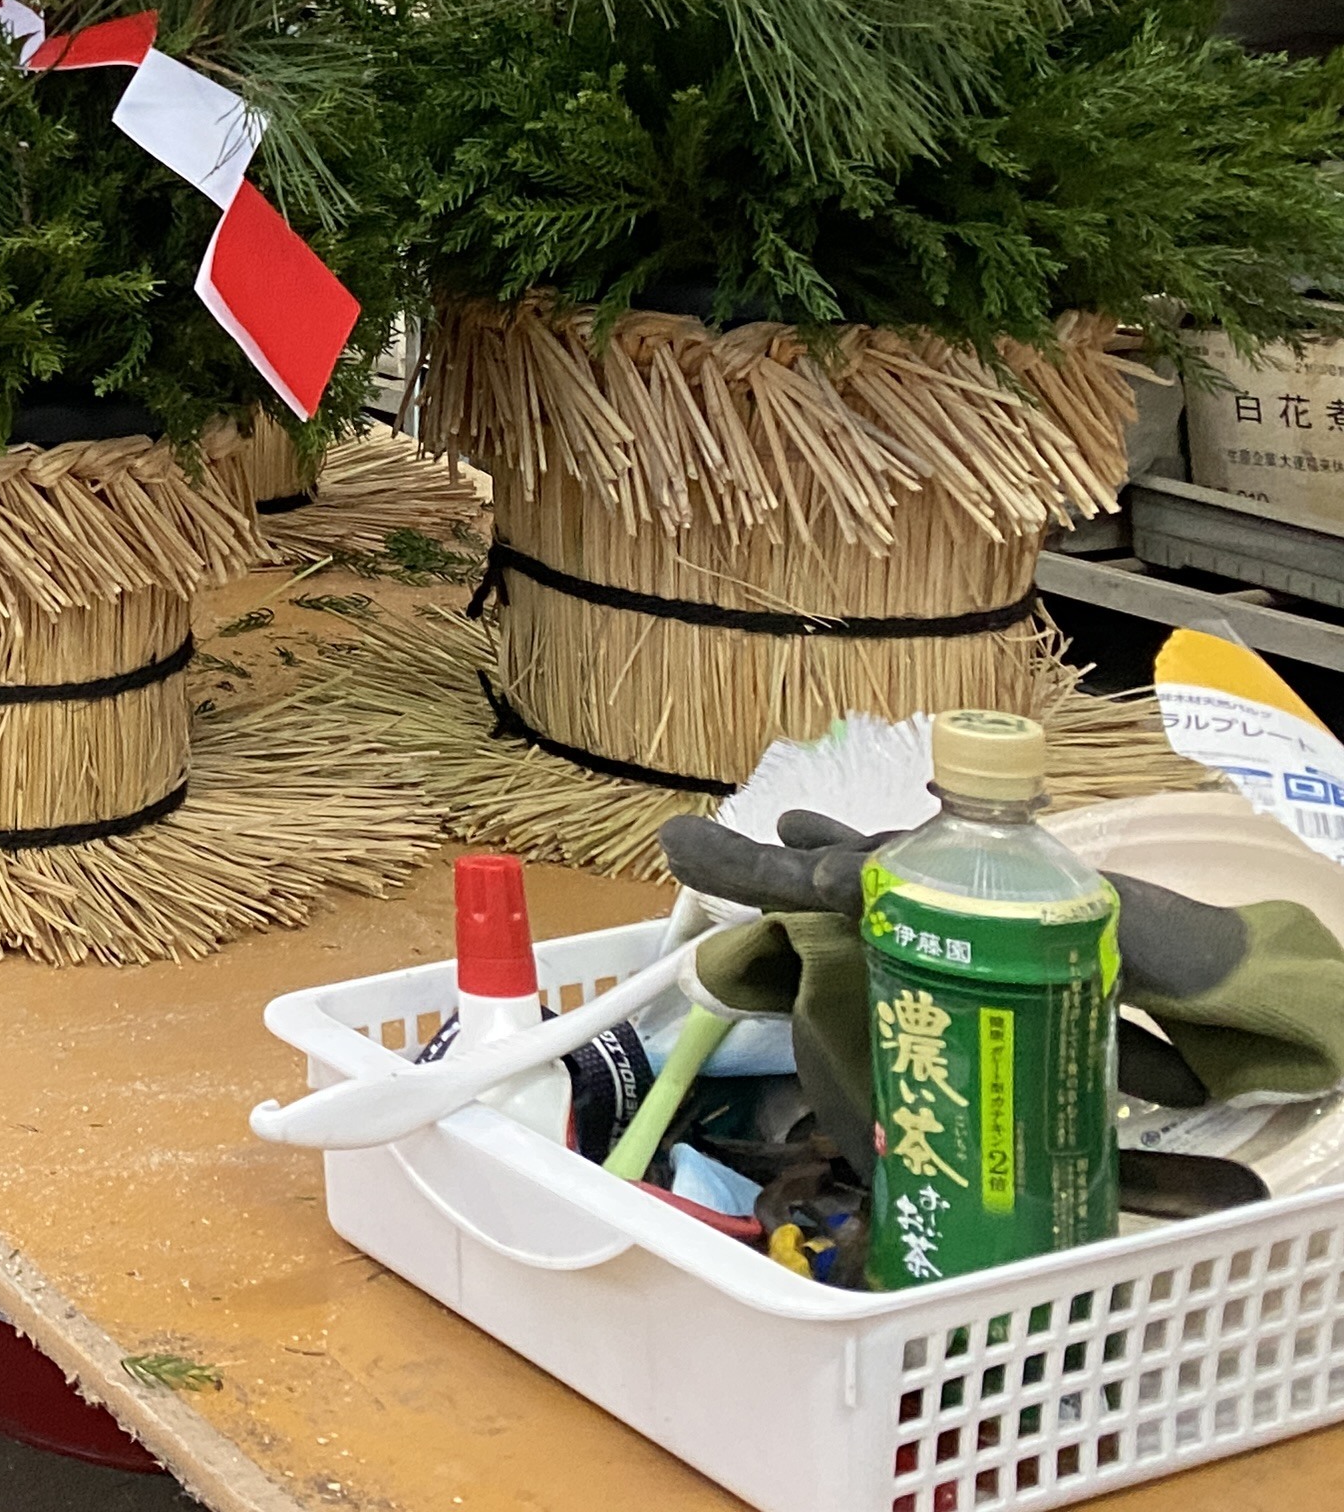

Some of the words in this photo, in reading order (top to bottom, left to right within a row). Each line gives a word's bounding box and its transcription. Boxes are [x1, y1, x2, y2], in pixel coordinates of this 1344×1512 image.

[893, 922, 972, 965] 伊藤園
[876, 989, 970, 1188] 濃い茶
